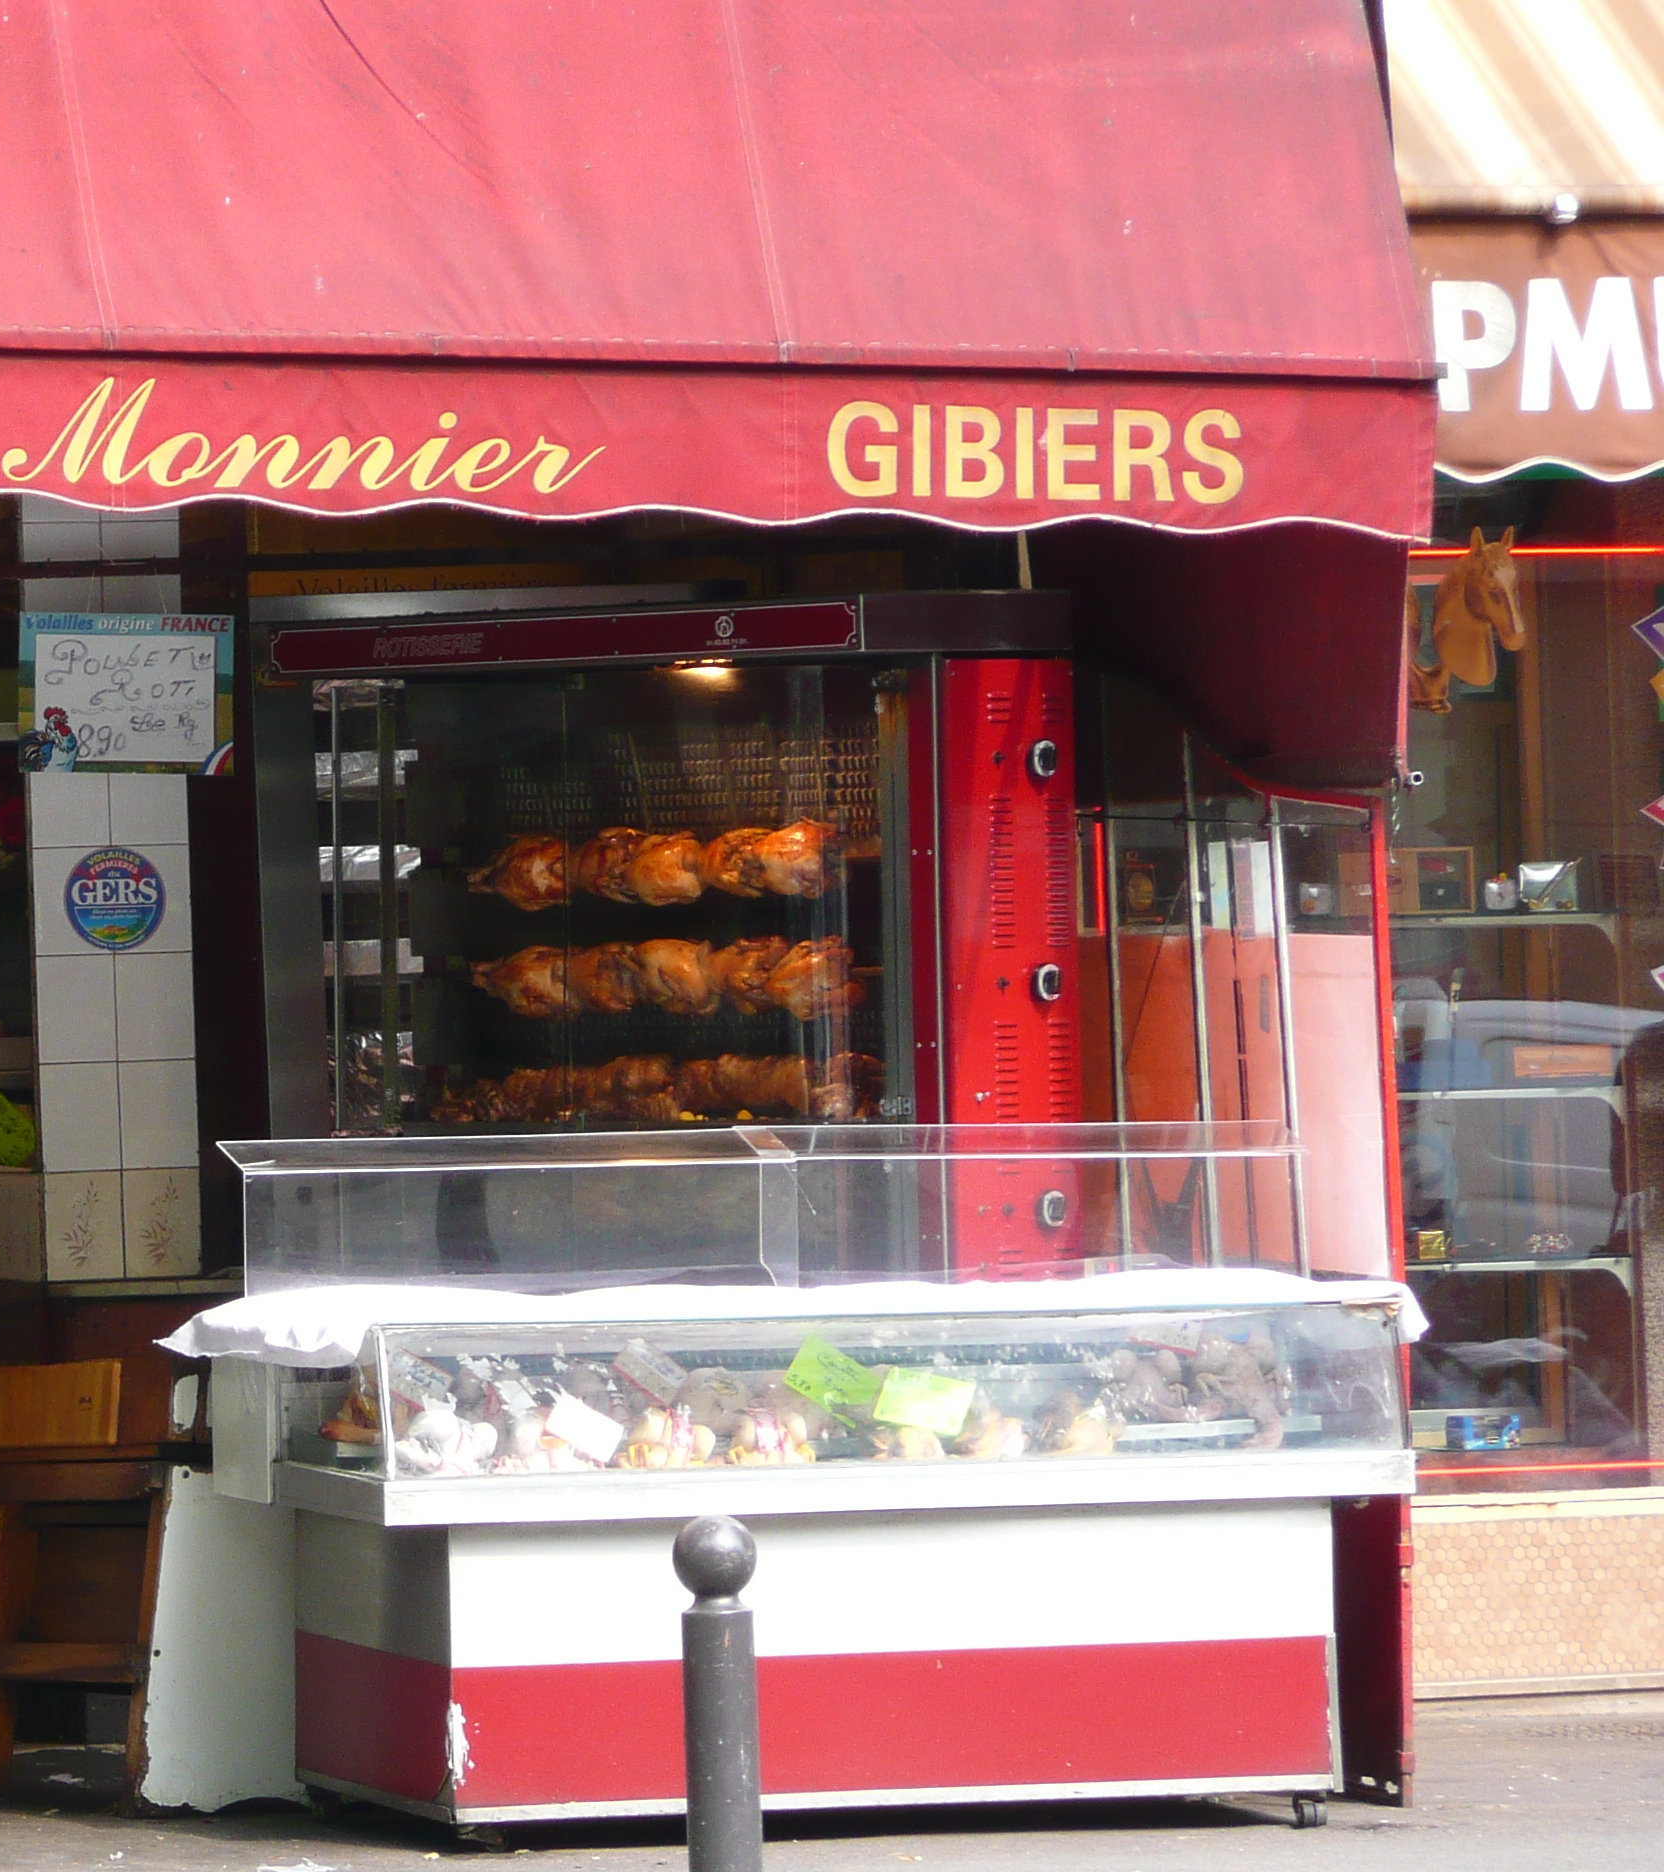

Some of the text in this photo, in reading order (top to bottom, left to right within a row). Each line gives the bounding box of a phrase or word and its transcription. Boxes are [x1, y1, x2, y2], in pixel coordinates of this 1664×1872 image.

[2, 377, 607, 494] Monnier
[828, 401, 1244, 504] GIBIERS
[25, 614, 229, 632] Volailles origine FRANCE
[373, 632, 485, 659] ROTISSERIE
[87, 850, 142, 865] VOLAILLES
[71, 878, 158, 905] GERS
